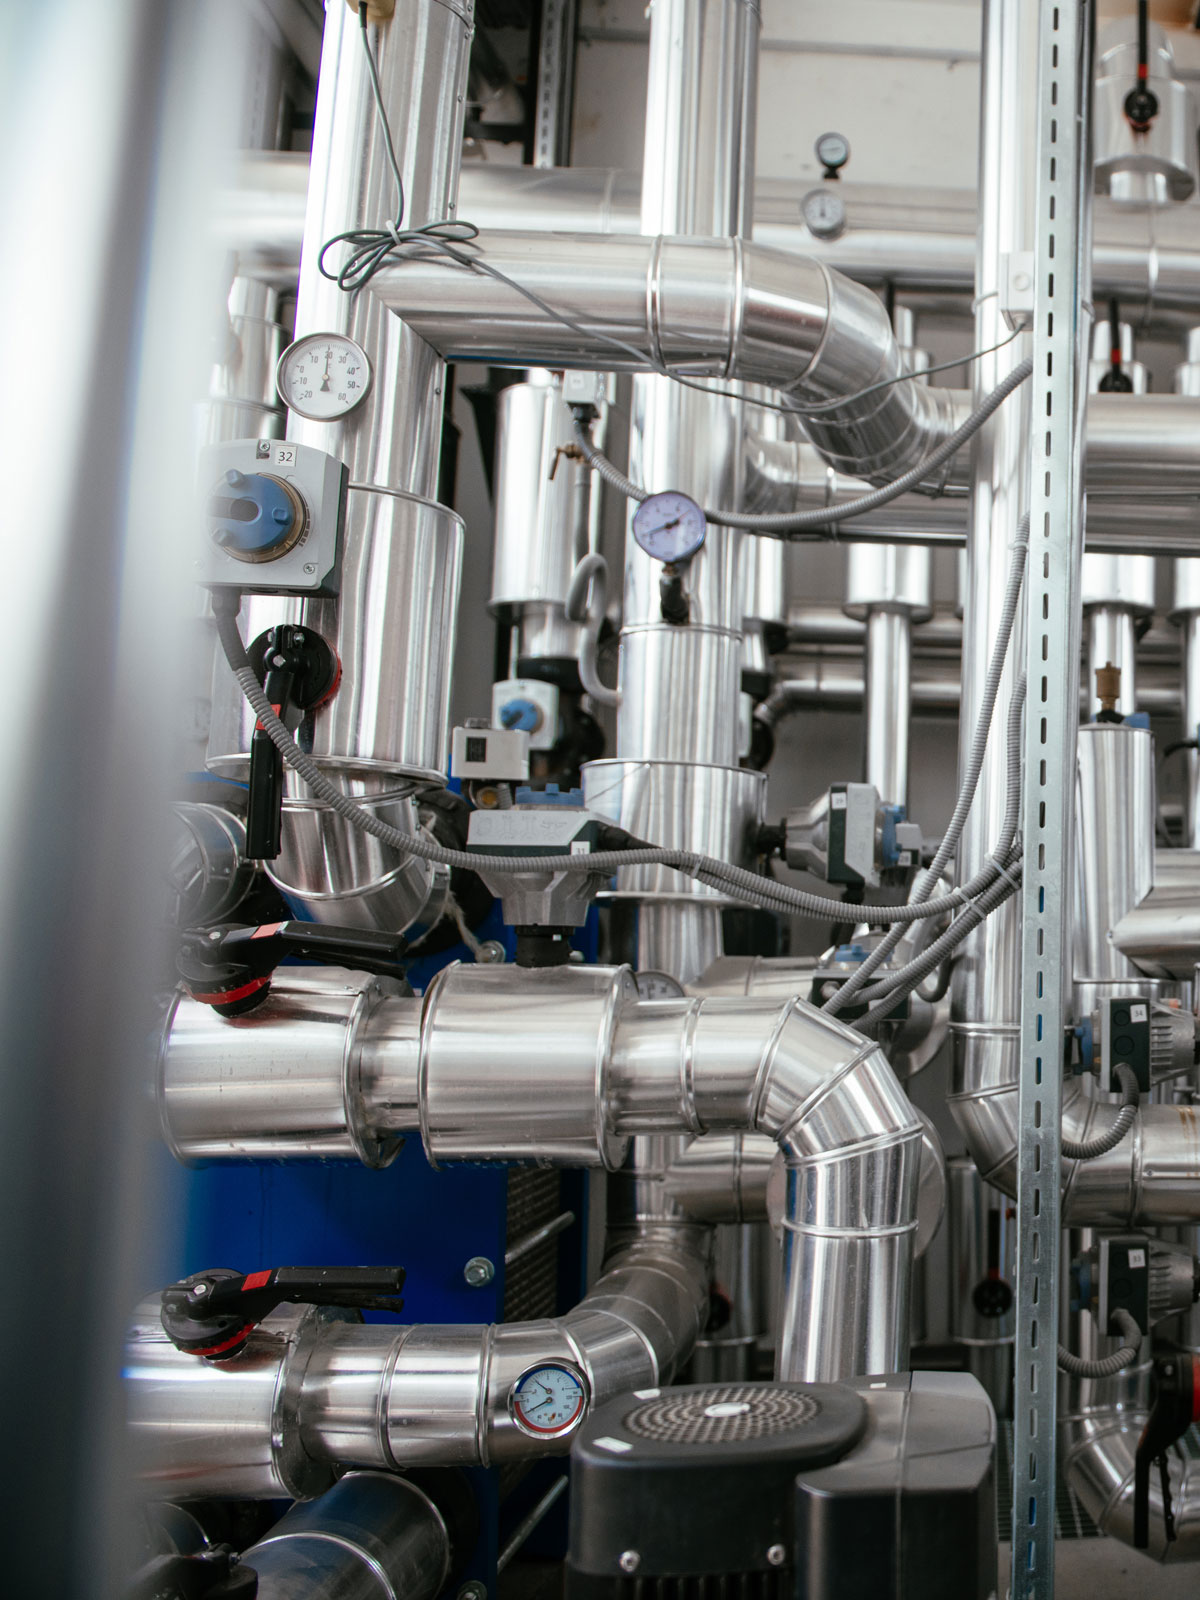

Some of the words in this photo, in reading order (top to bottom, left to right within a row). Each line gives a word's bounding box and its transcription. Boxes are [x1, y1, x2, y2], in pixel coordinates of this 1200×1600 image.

[347, 367, 355, 375] 40
[347, 381, 356, 389] 50
[279, 452, 293, 462] 32
